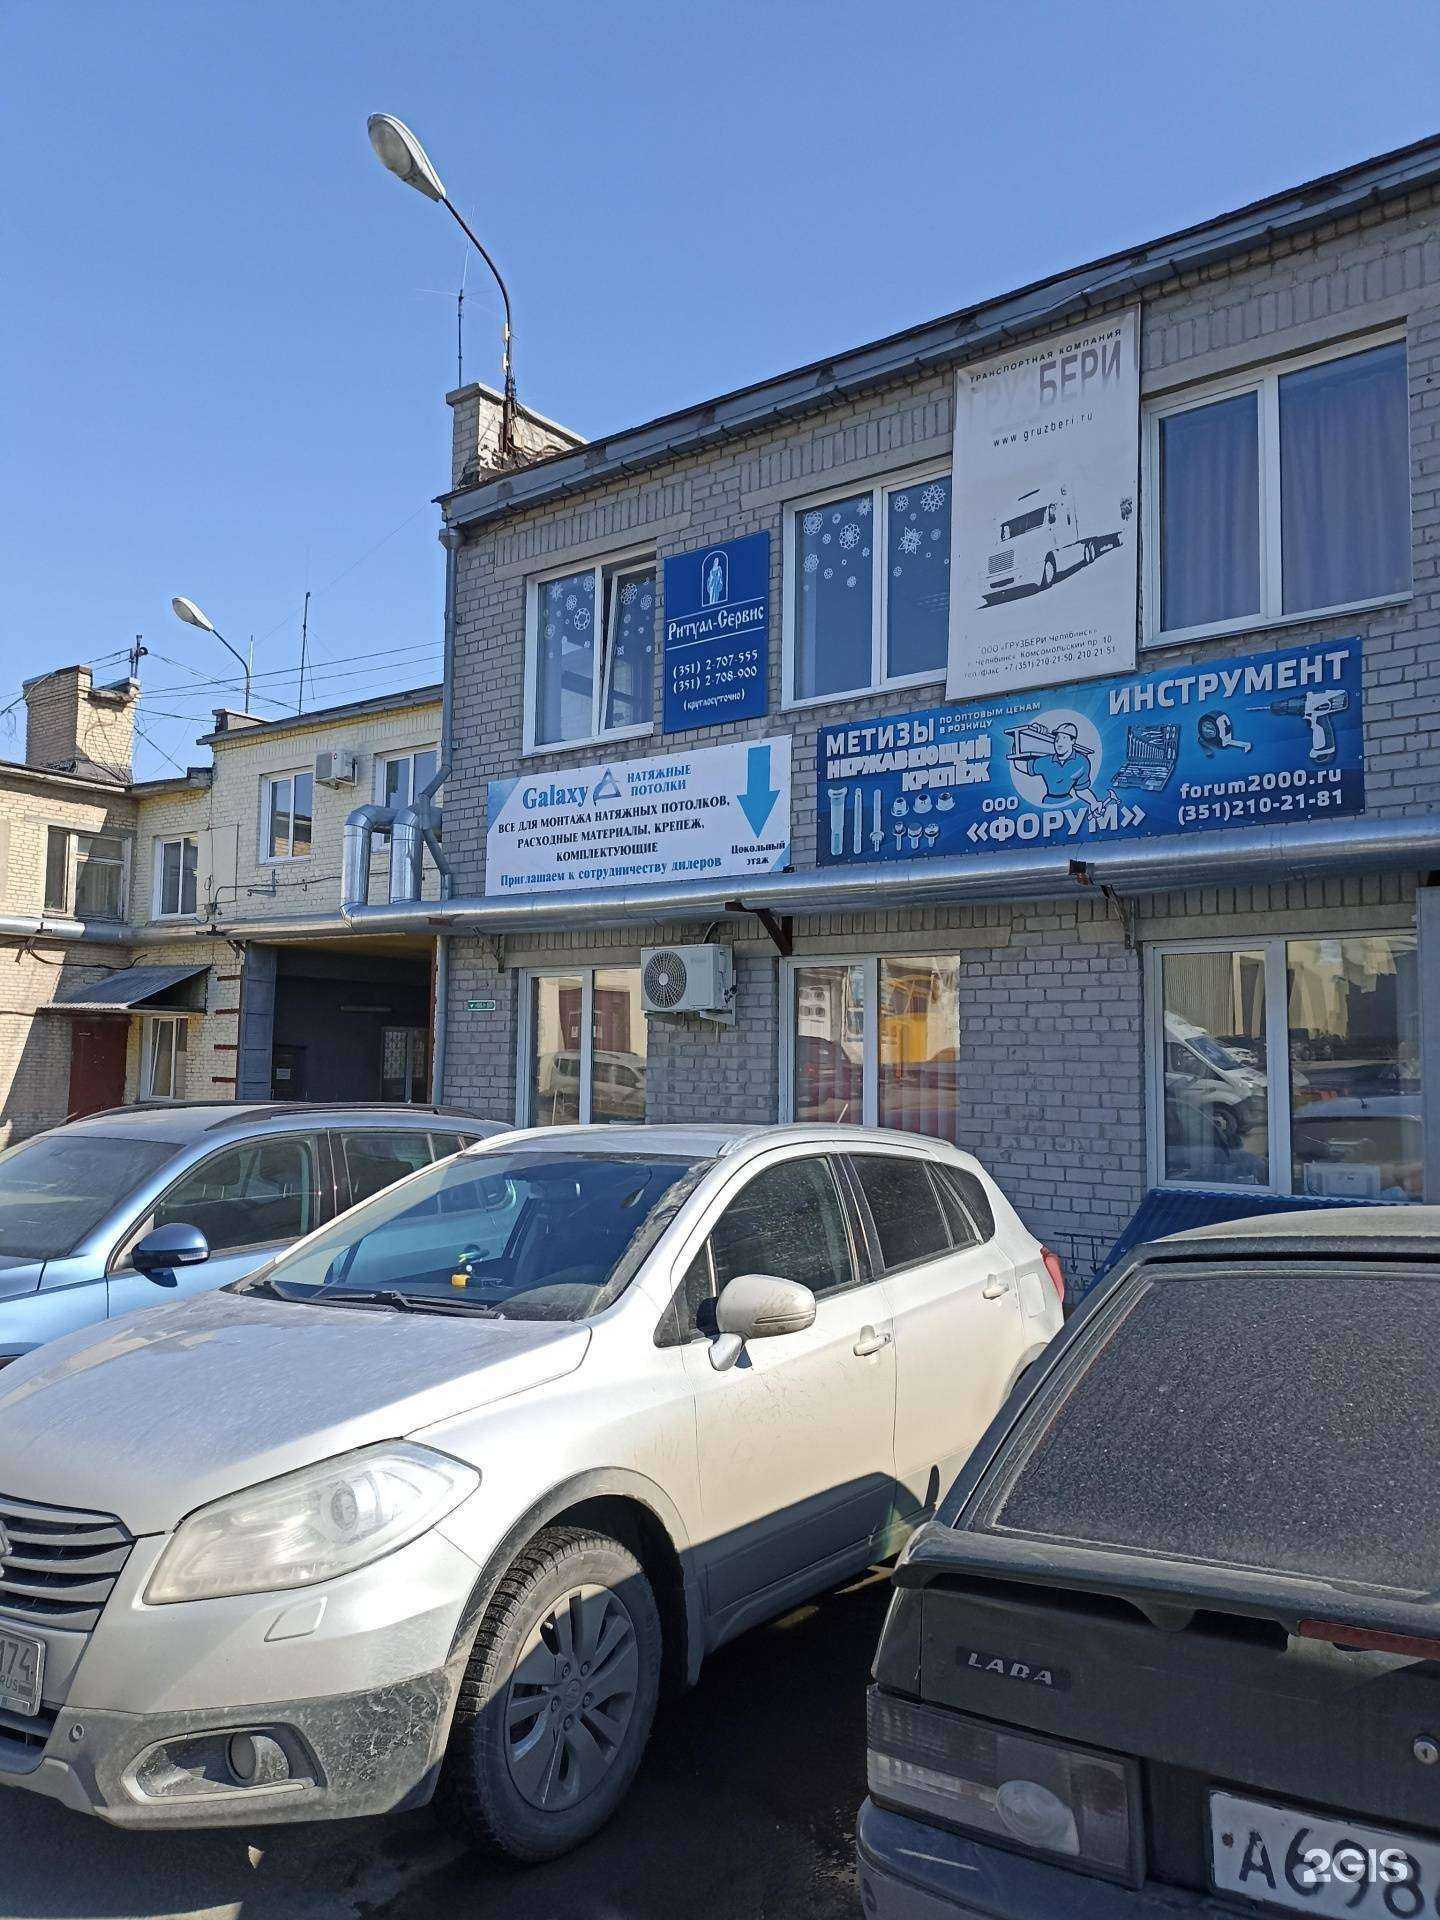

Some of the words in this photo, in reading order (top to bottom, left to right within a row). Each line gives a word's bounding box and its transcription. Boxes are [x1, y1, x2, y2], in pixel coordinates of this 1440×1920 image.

[970, 351, 1054, 383] ТРАНСПОРТНАЯ
[1059, 329, 1122, 354] КОМПАНИЯ
[667, 606, 765, 641] Ритуал-Сервис
[673, 660, 701, 679] (351)
[706, 649, 758, 671] 2-707-555
[673, 676, 701, 694] (351)
[705, 665, 757, 686] 2-708-900
[1109, 650, 1350, 716] ИНСТРУМЕНТ
[683, 688, 746, 712] (круглосуточно)
[939, 714, 953, 725] ПО
[955, 707, 1004, 721] ОПТОВЫМ
[1006, 701, 1042, 715] ЦЕНАМ
[826, 718, 935, 757] МЕТИЗЫ
[939, 725, 946, 734] В
[947, 719, 993, 733] РОЗНИЦУ
[826, 734, 992, 780] НЕРЖАВЕЮЩИЙ
[627, 764, 692, 783] НАТЯЖНЫЕ
[631, 779, 687, 797] ПОТОЛКИ
[1180, 768, 1342, 800] forum2000.ru
[522, 784, 589, 810] Galaxy
[982, 796, 1019, 813] ООО
[1178, 788, 1342, 826] (351)210-21-81
[498, 822, 516, 834] ВСЕ
[518, 819, 538, 832] ДЛЯ
[540, 812, 592, 828] МОНТАЖА
[595, 804, 658, 822] НАТЯЖНЫХ
[966, 800, 1146, 844] «ФОРУМ»
[517, 832, 579, 849] РАСХОДНЫЕ
[581, 824, 651, 842] МАТЕРИАЛЫ,
[731, 840, 786, 856] Цокольный
[556, 842, 659, 862] КОМПЛЕКТУЮЩИЕ
[746, 855, 770, 867] этаж
[500, 871, 566, 888] Приглашаем
[568, 871, 576, 880] к
[578, 859, 668, 881] сотрудничеству
[671, 856, 722, 872] дилеров
[968, 1653, 1052, 1685] LADA
